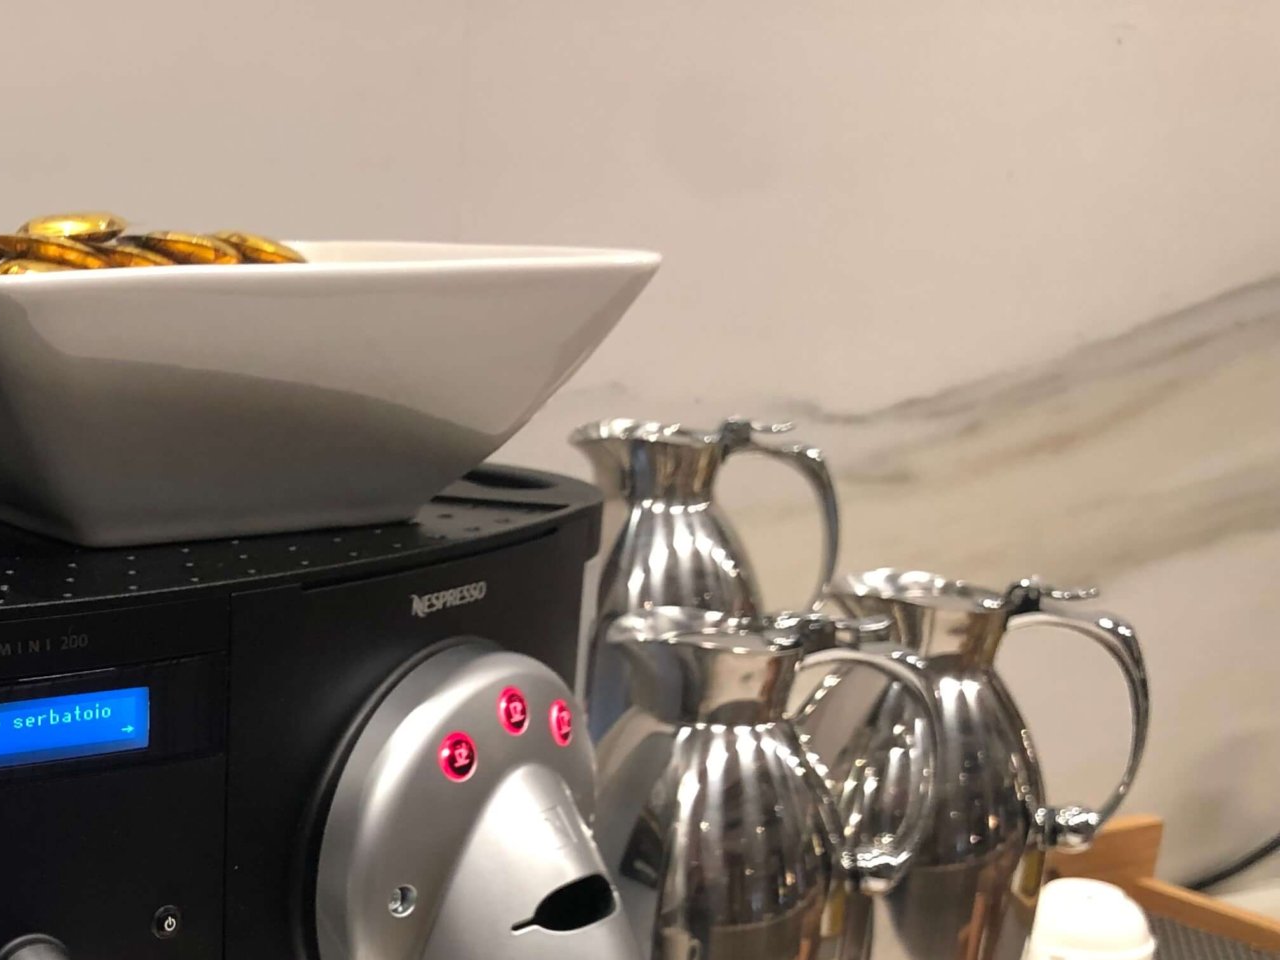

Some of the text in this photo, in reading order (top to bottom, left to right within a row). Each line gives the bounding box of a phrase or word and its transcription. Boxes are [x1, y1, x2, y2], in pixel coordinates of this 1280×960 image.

[409, 581, 487, 617] NESPRESSO
[60, 633, 89, 651] 200
[13, 703, 112, 730] serbatoio
